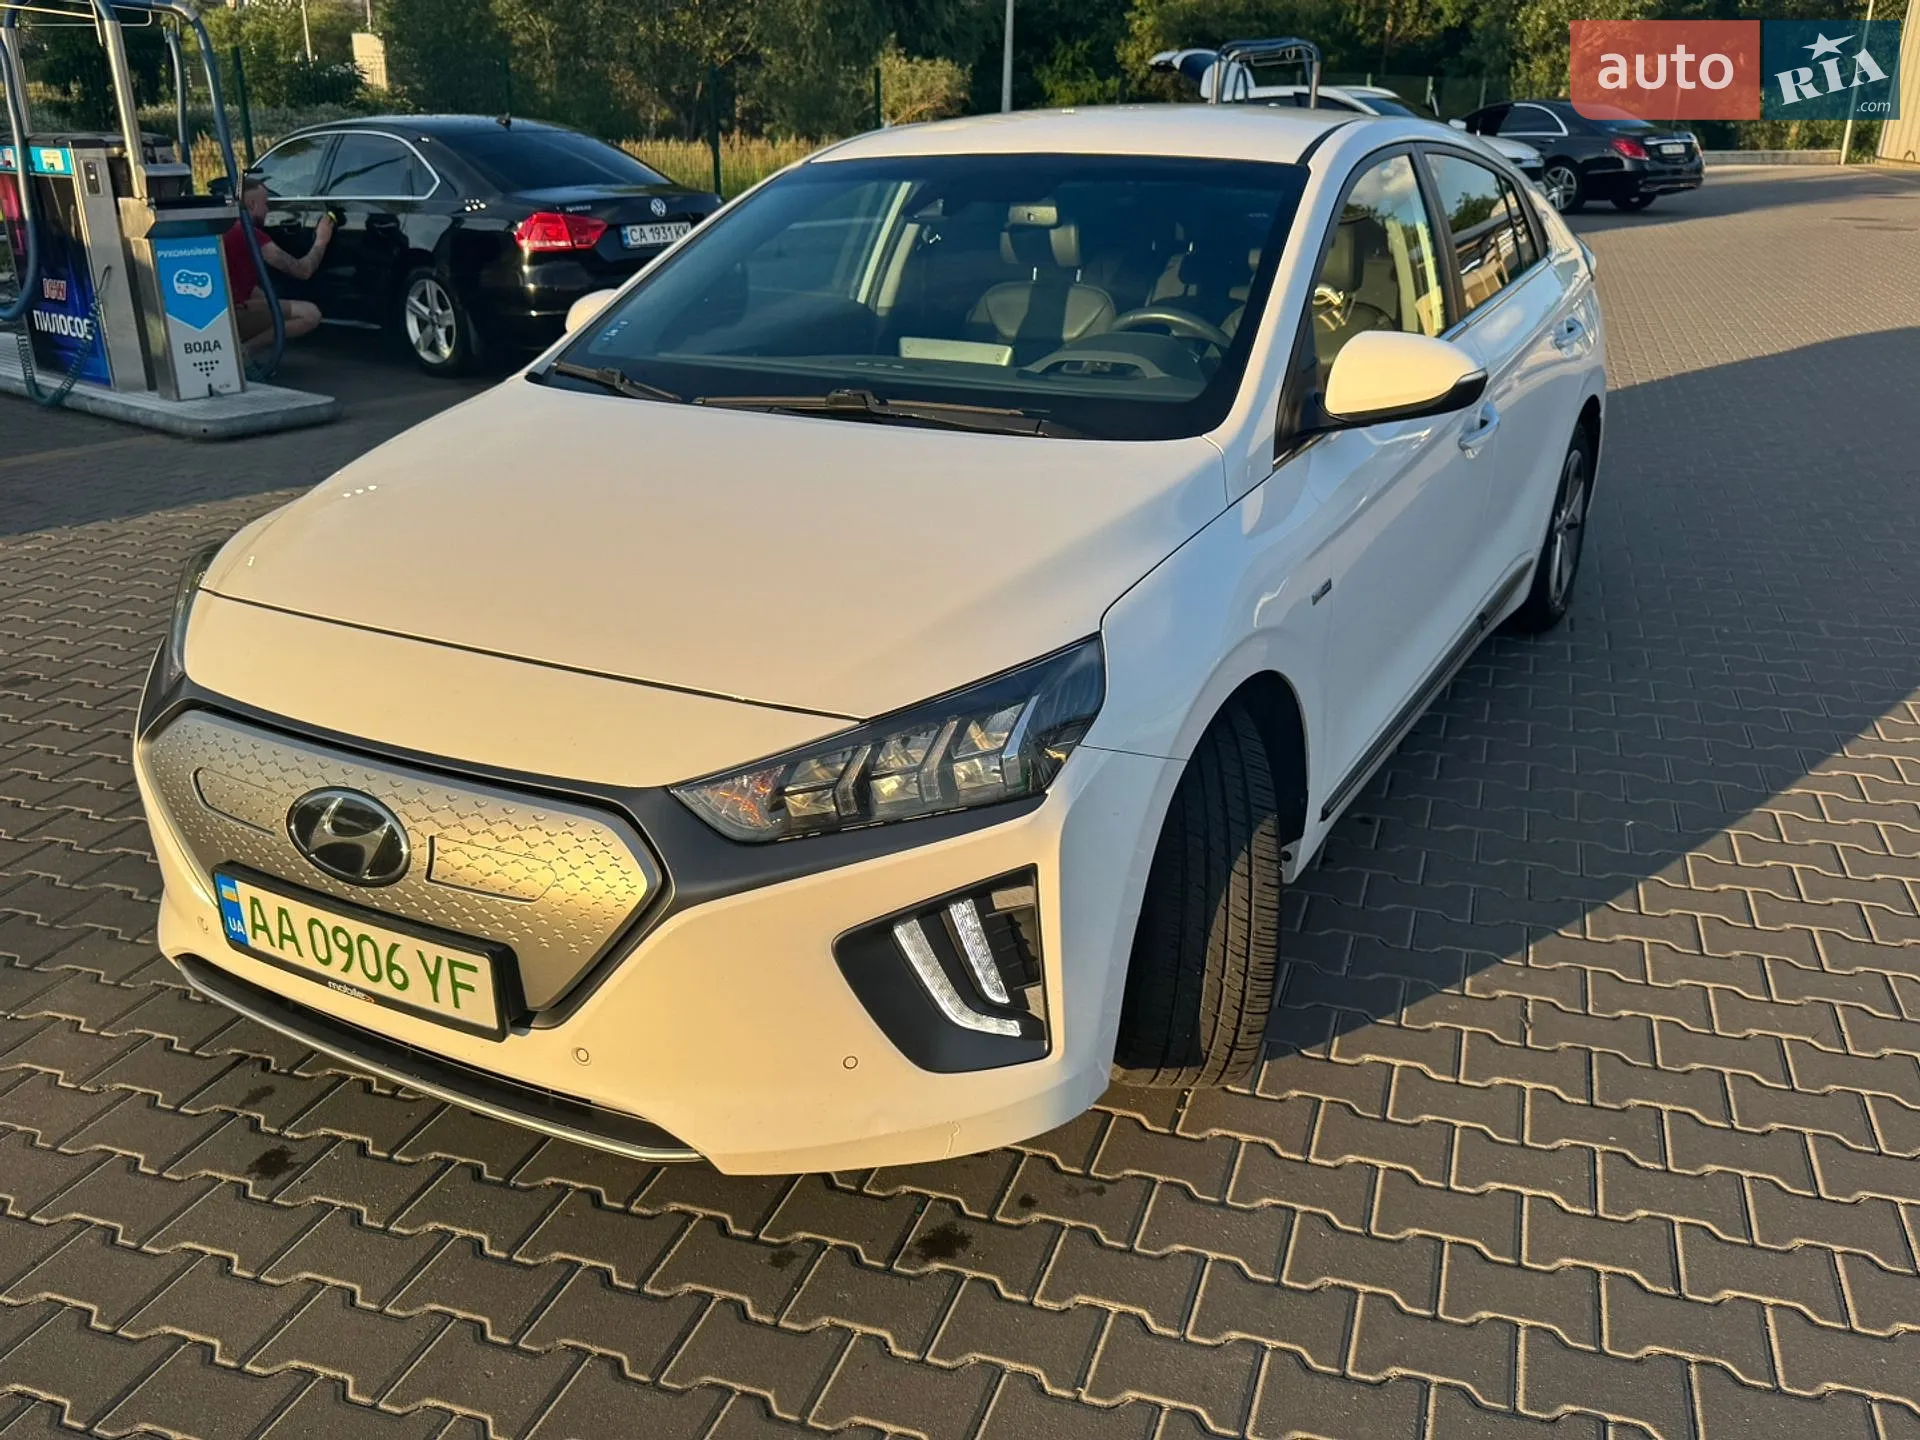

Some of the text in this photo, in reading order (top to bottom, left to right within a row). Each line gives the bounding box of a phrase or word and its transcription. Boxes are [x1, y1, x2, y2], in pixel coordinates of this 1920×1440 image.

[629, 227, 648, 243] CA
[650, 225, 673, 242] 1931
[184, 340, 222, 355] ВОДА
[228, 895, 479, 1009] UA AA 0906 YF
